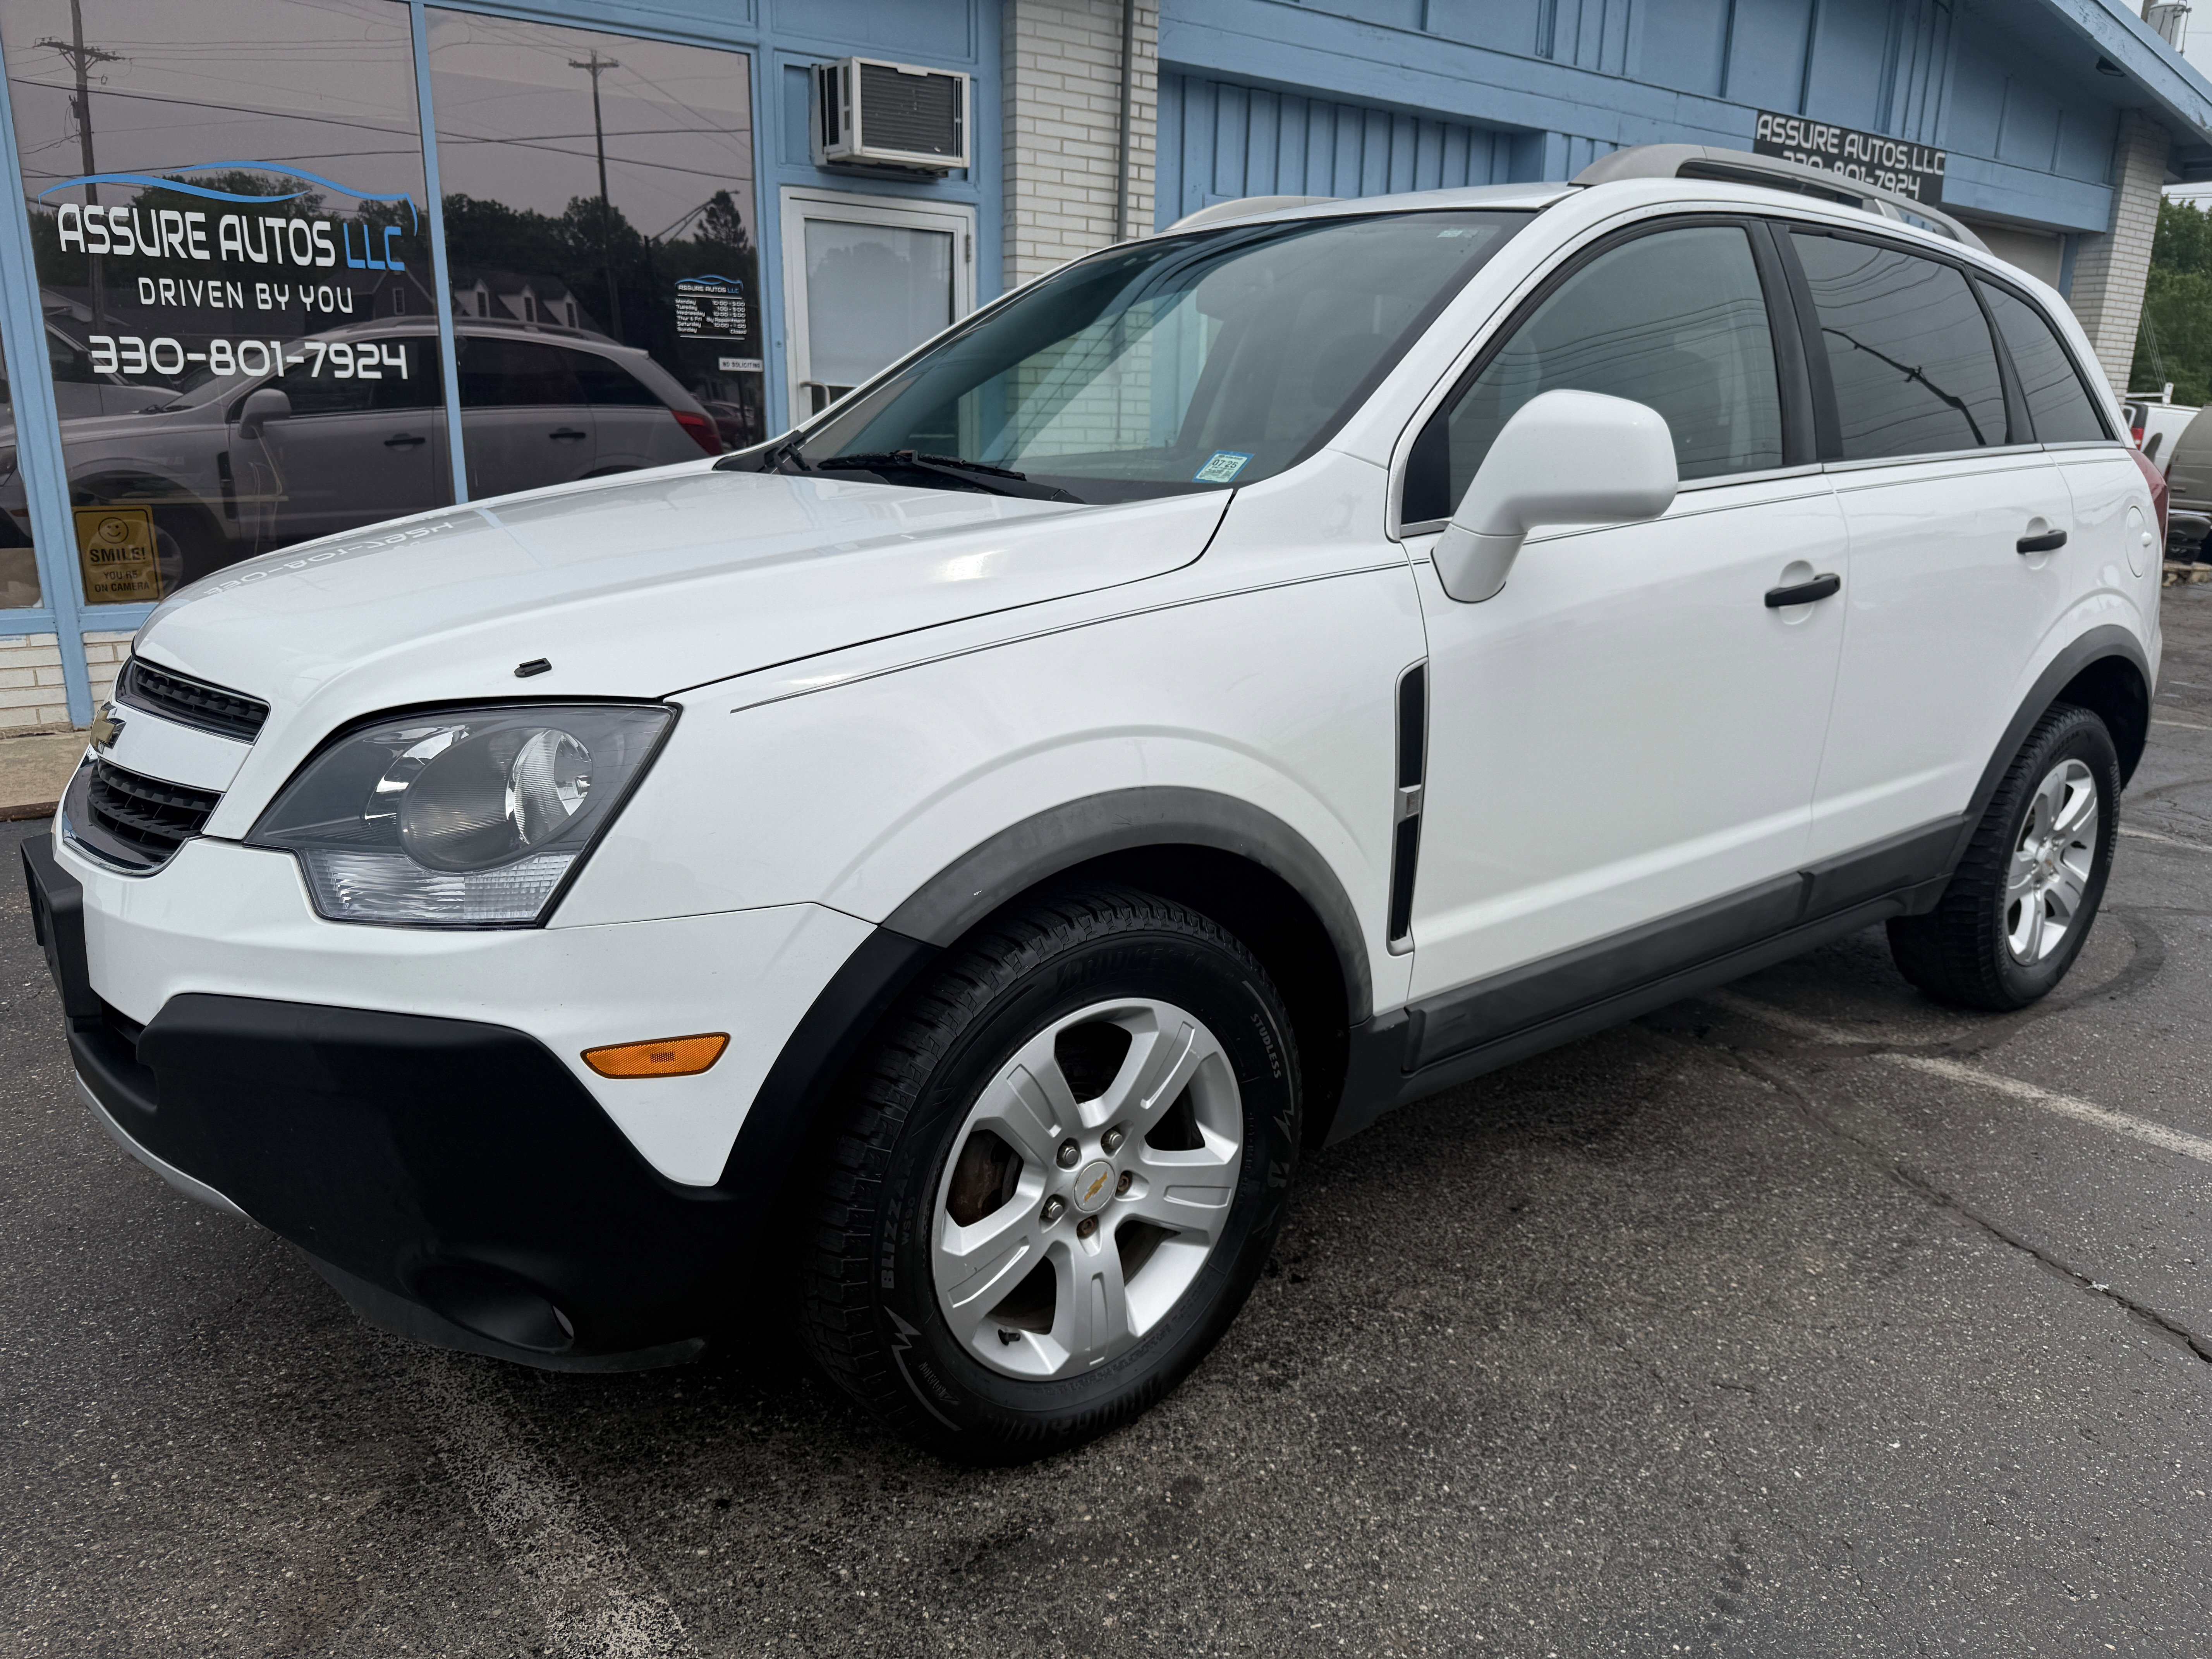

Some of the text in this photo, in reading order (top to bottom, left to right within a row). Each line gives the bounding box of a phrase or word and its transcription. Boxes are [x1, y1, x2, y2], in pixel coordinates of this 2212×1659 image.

[1757, 114, 1841, 154] ASSURE
[58, 203, 405, 271] ASSURE AUTOS LLC
[138, 277, 353, 314] DRIVEN BY YOU
[89, 335, 409, 380] 330-801-7924
[90, 547, 146, 563] SMILE!
[103, 570, 138, 580] YOURE
[95, 582, 150, 592] ON CAMERA
[1250, 1013, 1281, 1079] STUDLESS
[881, 1151, 916, 1289] BLIZZAK
